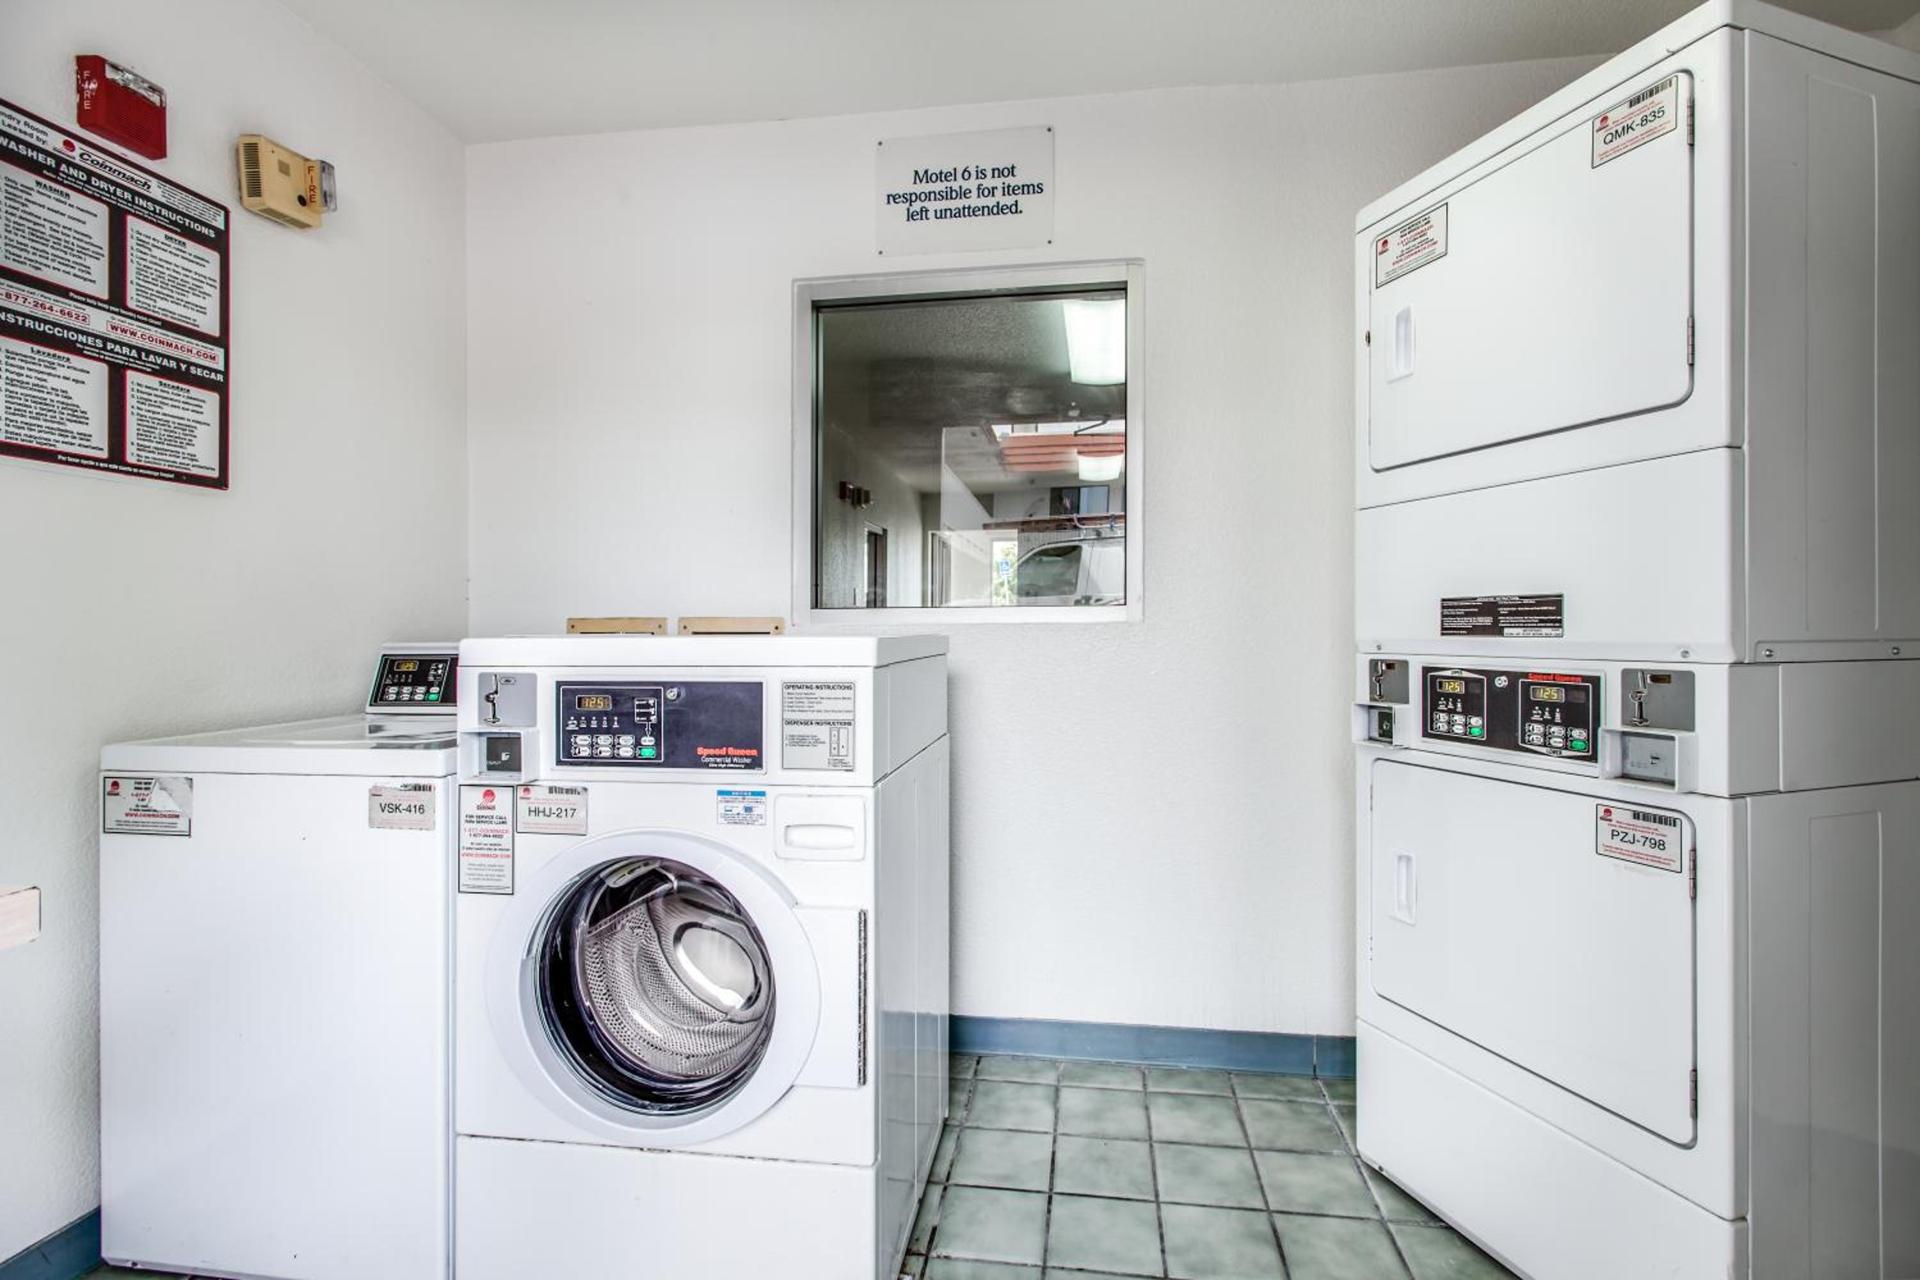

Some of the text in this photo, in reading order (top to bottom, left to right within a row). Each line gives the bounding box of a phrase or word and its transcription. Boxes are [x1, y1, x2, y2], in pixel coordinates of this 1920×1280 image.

[0, 111, 49, 137] ndry Room
[2, 119, 47, 146] Leased by
[1603, 105, 1666, 145] QMK-835
[79, 152, 152, 190] Coinmach
[307, 165, 317, 203] FIRE
[912, 163, 1016, 185] Motel 6 is not
[35, 180, 71, 199] WASHER
[60, 163, 87, 181] AND
[91, 176, 132, 201] DRYER
[135, 196, 215, 238] INSTRUCTIONS
[886, 181, 1044, 207] responsible for items
[906, 200, 1023, 222] left unattended.
[0, 292, 88, 322] -877-264-6622
[0, 311, 103, 348] NSTRUCCIONES
[107, 343, 138, 358] PARA
[141, 351, 177, 369] LAVAR
[179, 362, 187, 371] Y
[190, 367, 224, 382] SECAR
[110, 323, 217, 362] WWW.COINMACH.COM
[697, 747, 758, 756] Speed Queen
[379, 803, 425, 815] VSK-416
[528, 806, 577, 818] HHJ-217
[1611, 829, 1666, 851] PZJ-798
